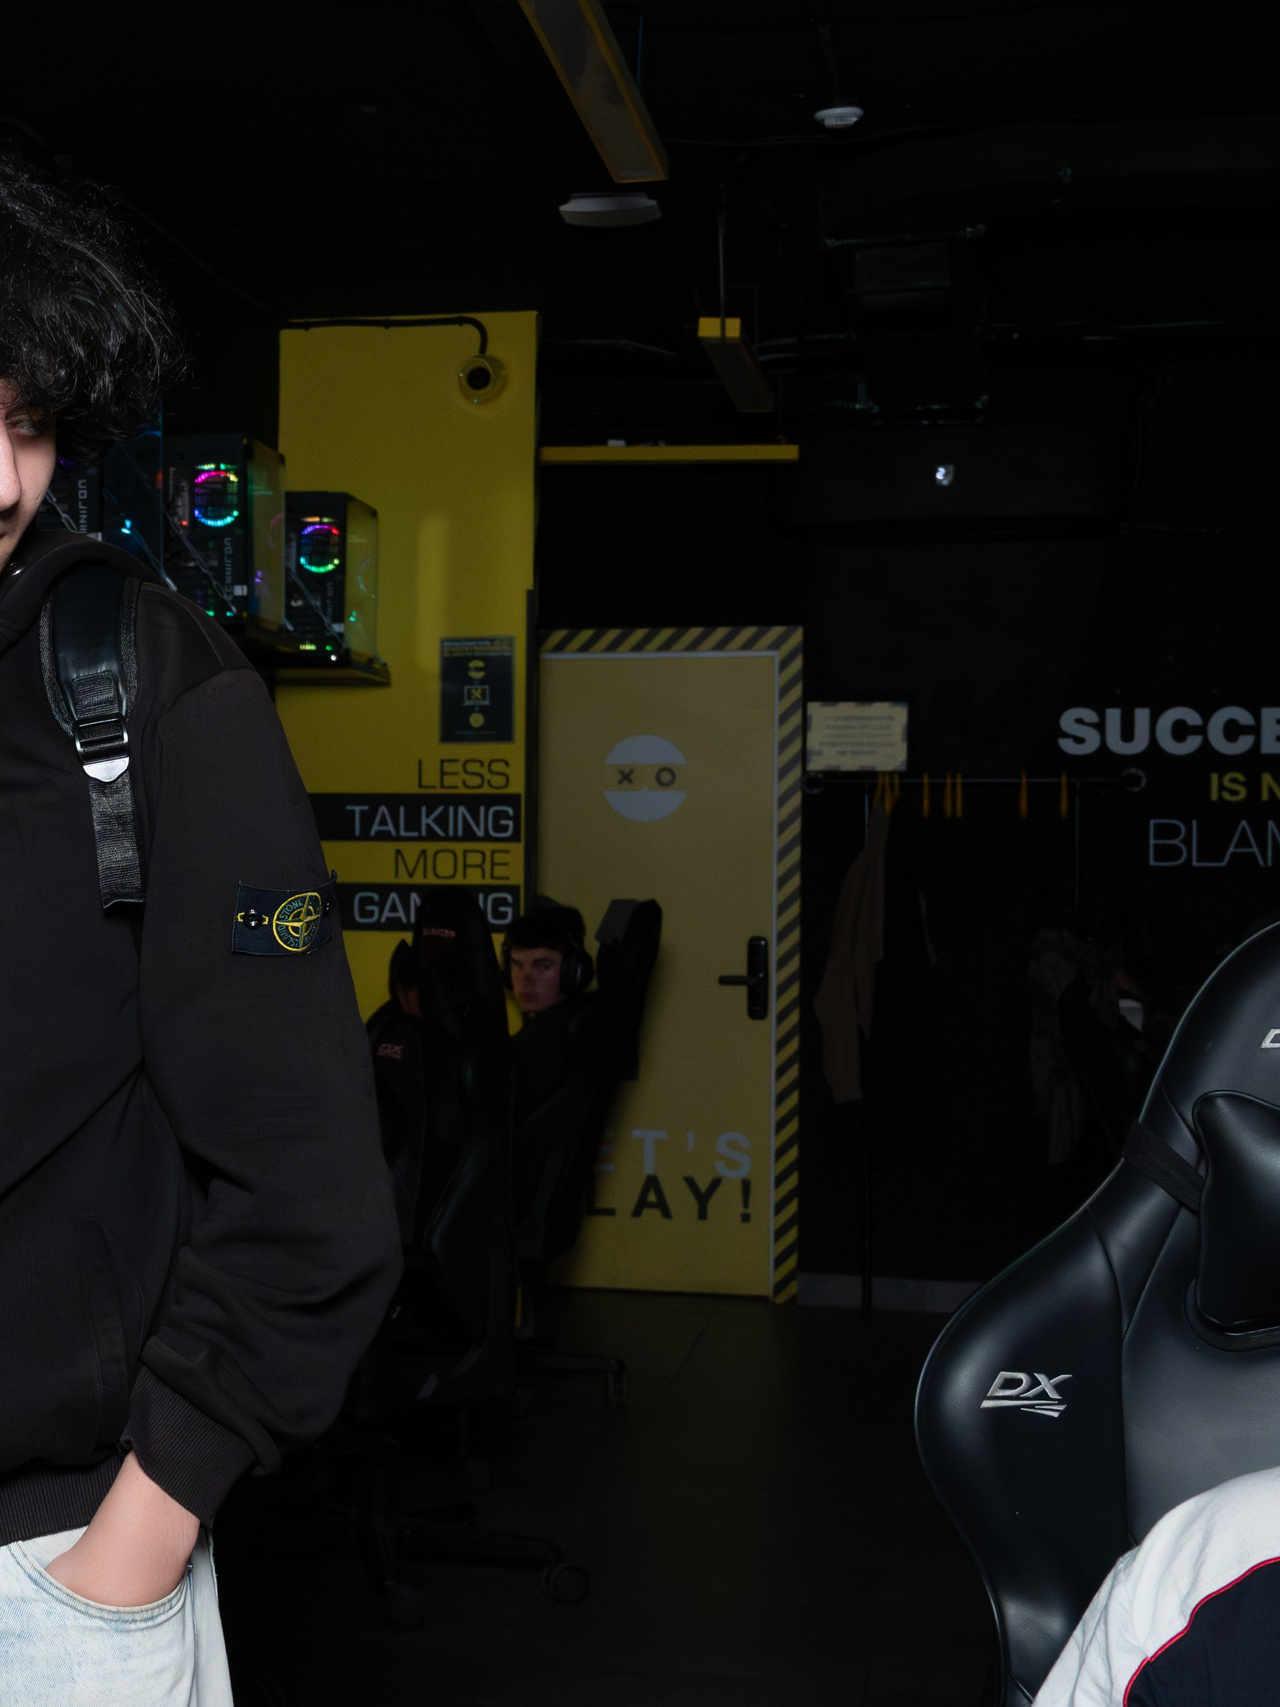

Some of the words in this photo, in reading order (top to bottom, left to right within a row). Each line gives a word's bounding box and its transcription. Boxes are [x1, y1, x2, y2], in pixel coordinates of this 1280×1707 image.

[417, 758, 510, 790] LESS
[1208, 771, 1248, 803] IS
[345, 804, 515, 839] TALKING
[394, 848, 511, 881] MORE
[278, 898, 304, 920] STONE
[986, 1370, 1073, 1399] DX
